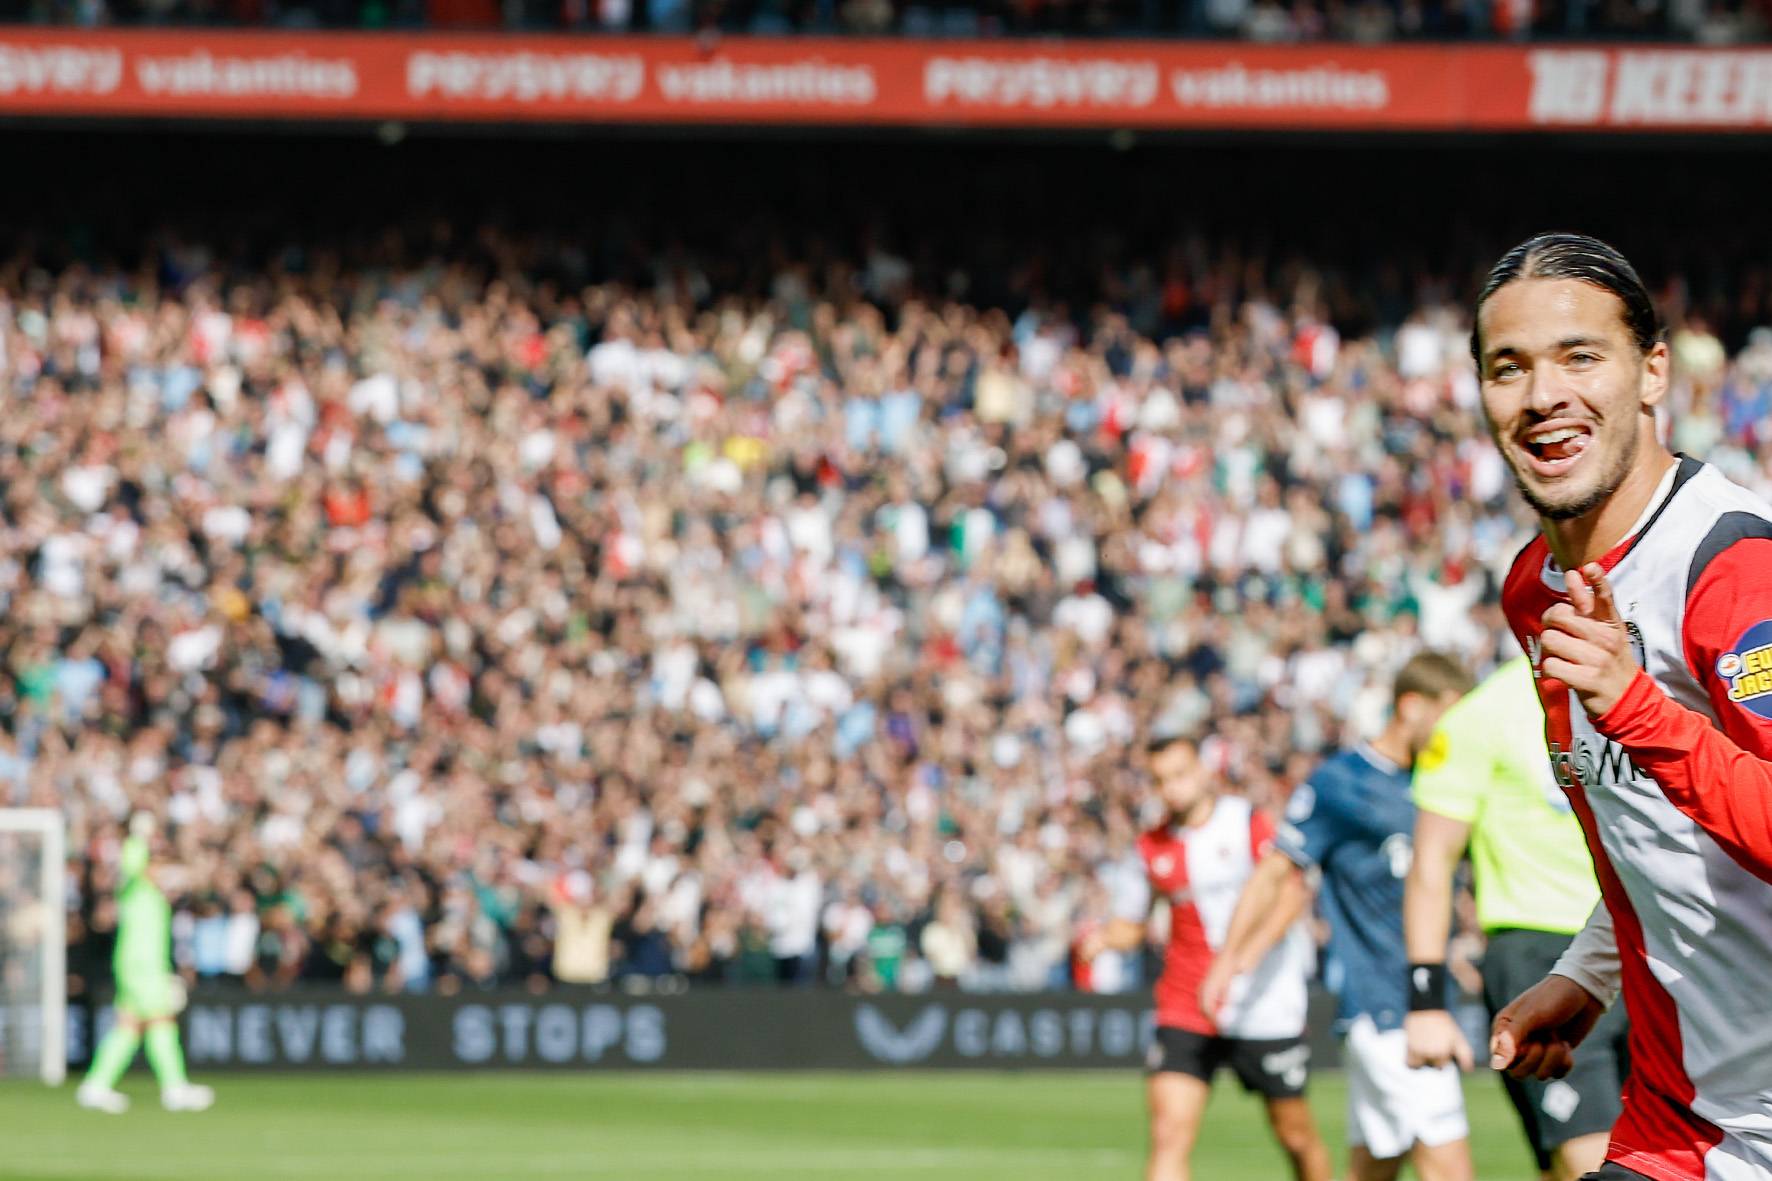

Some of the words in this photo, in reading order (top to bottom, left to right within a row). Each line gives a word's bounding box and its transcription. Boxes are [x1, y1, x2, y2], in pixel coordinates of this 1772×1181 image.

[137, 49, 358, 97] vakanties
[658, 54, 876, 104] vakanties
[1172, 62, 1388, 109] vakanties
[189, 1005, 405, 1062] NEVER
[453, 1004, 666, 1062] STOPS
